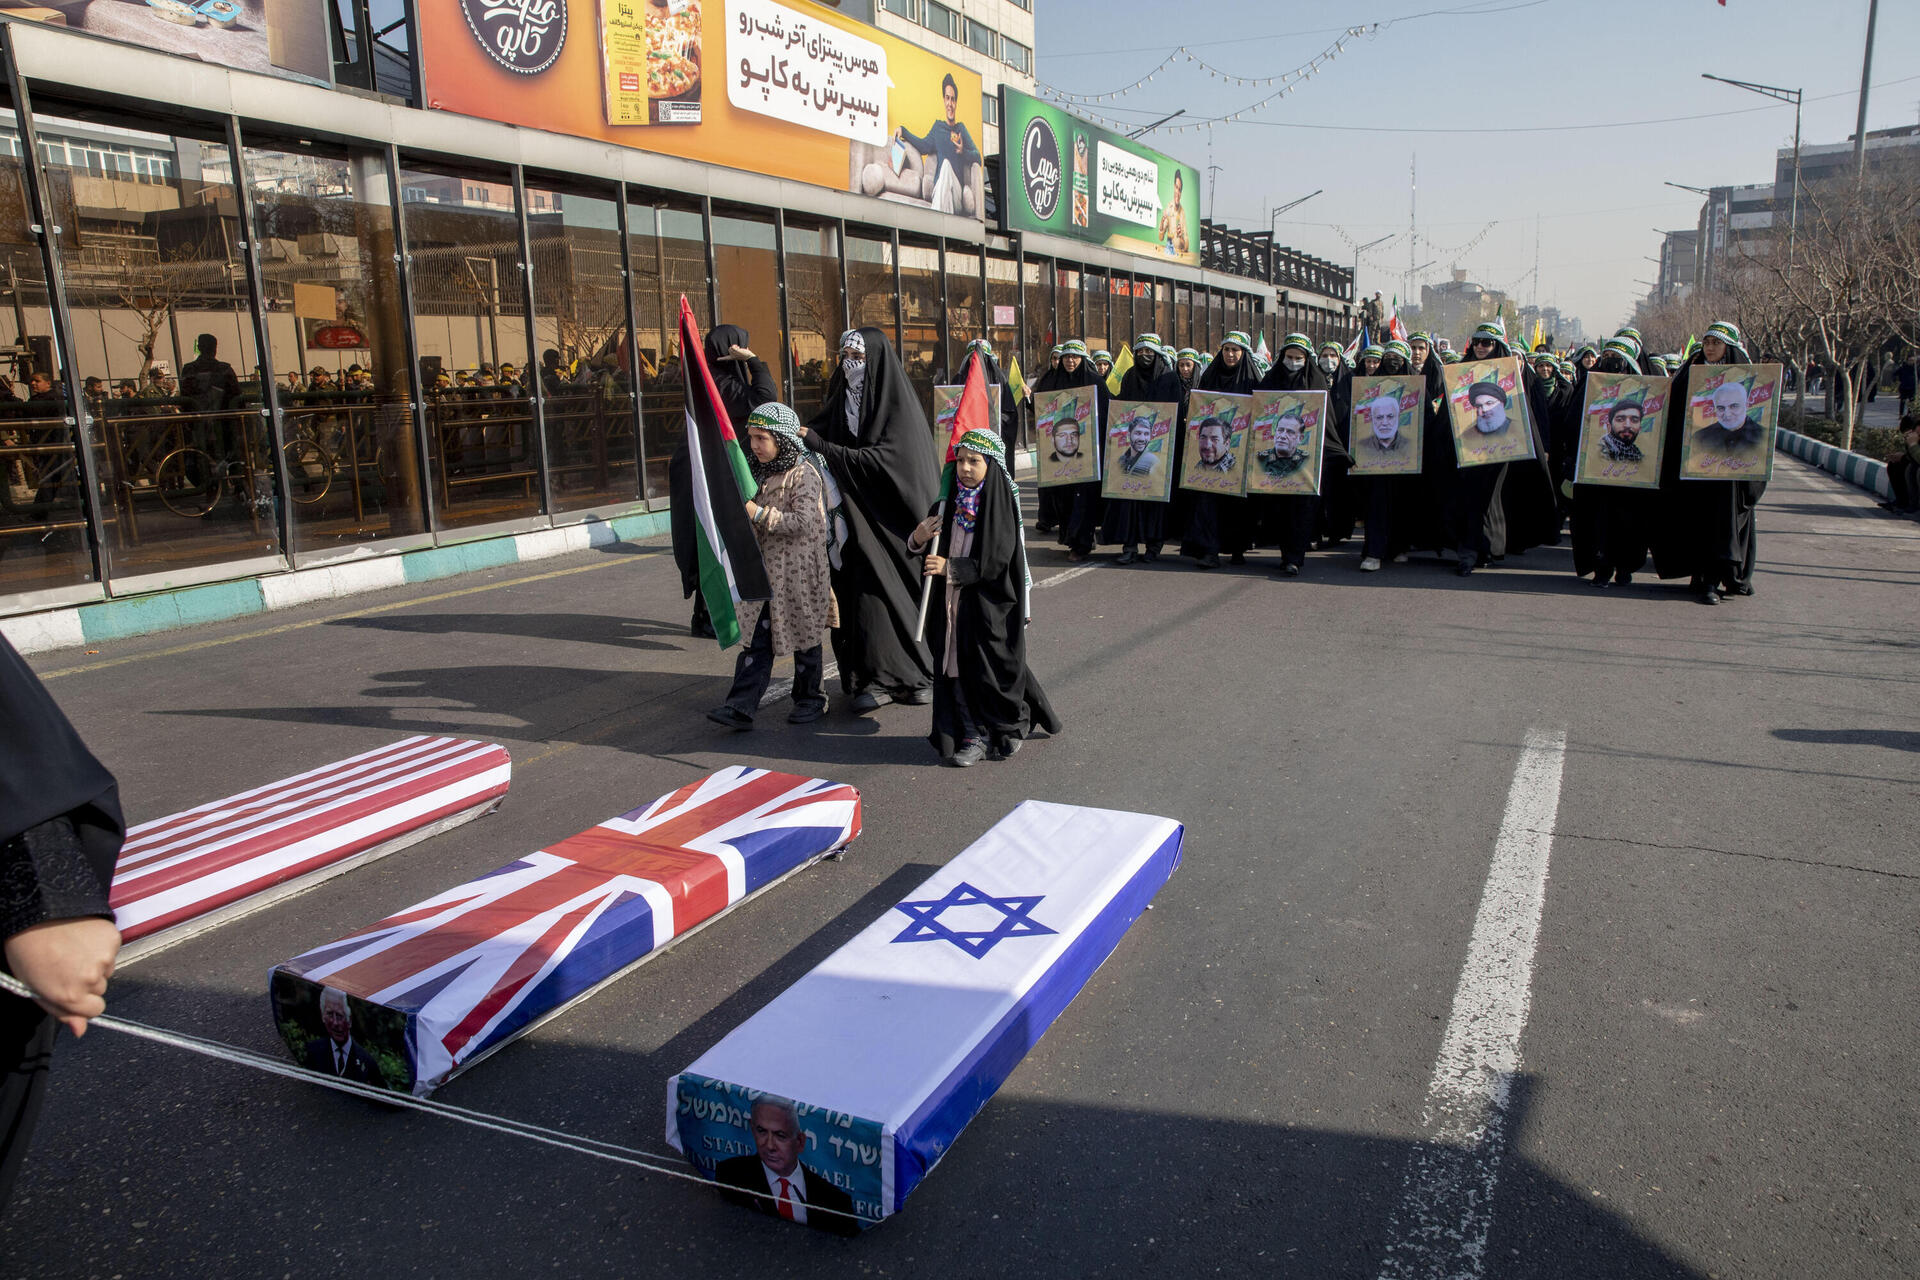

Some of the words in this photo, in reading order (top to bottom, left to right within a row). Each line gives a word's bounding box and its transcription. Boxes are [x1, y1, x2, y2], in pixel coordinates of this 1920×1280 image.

[739, 12, 753, 36] رو
[755, 14, 784, 40] شب
[785, 24, 806, 50] آخر
[496, 23, 548, 62] کاپو
[807, 33, 843, 73] پیتزای
[740, 55, 789, 102] کاپو
[844, 56, 879, 77] هوس
[792, 70, 810, 106] به
[813, 73, 880, 127] بسپرش
[1026, 127, 1059, 187] Capo
[1034, 185, 1055, 213] کاپو
[1102, 180, 1119, 210] کاپو
[1120, 188, 1127, 210] به
[1127, 186, 1153, 219] بسپرش
